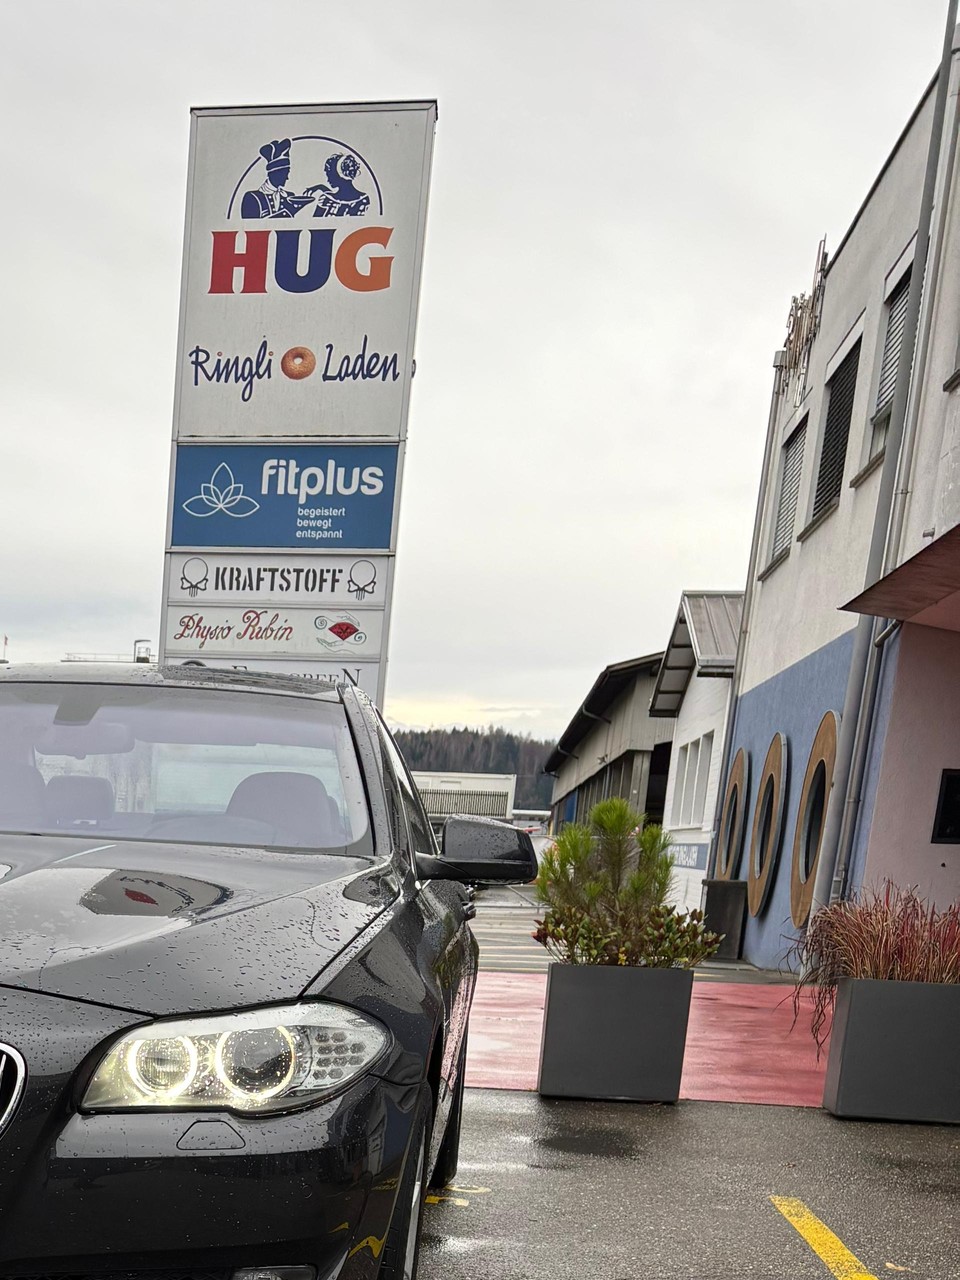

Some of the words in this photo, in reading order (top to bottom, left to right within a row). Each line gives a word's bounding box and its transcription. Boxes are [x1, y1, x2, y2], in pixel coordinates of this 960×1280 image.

[208, 226, 395, 294] HUG
[189, 340, 274, 402] Ringli
[322, 334, 400, 382] Laden
[261, 459, 384, 504] fitplus
[296, 517, 333, 530] bewegt
[297, 506, 346, 518] begeistert
[295, 529, 343, 540] entspannt
[214, 567, 343, 593] KRAFTSTOFF
[173, 613, 235, 649] Physio
[236, 609, 294, 641] Rubin
